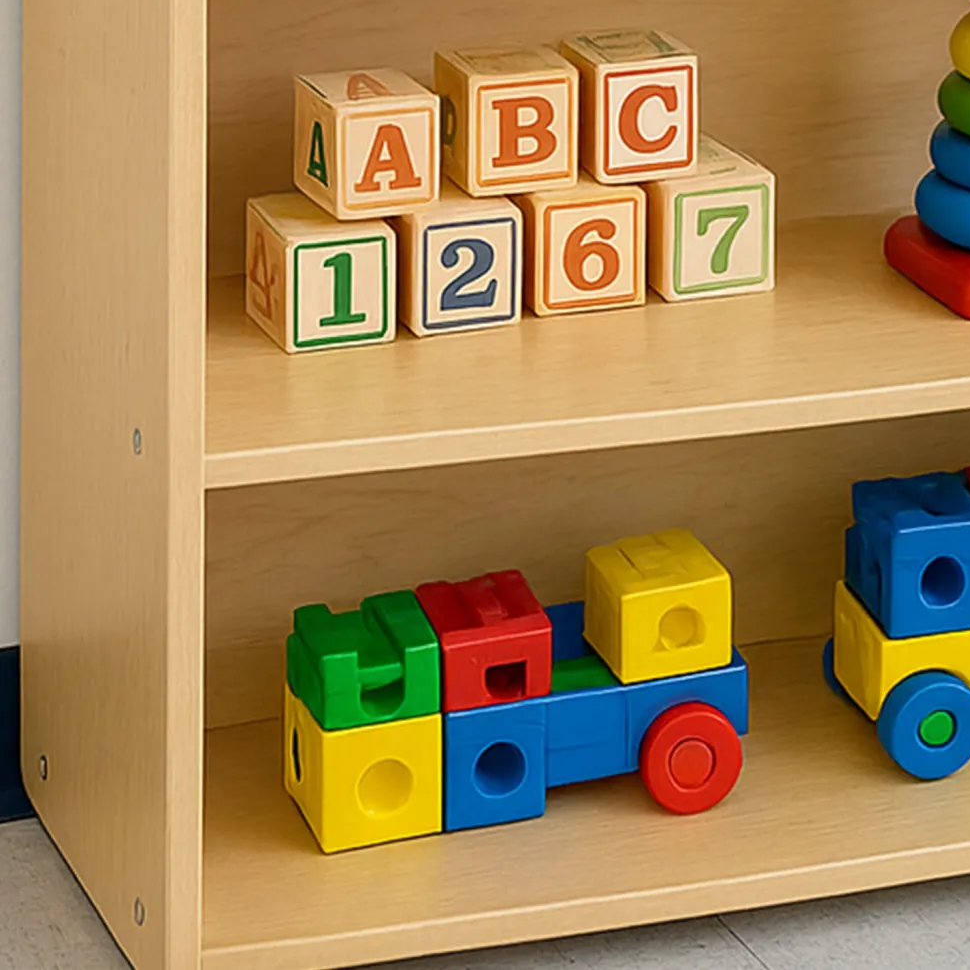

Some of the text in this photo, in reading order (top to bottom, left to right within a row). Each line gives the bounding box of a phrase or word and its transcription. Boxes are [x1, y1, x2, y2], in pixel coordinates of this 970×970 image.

[491, 96, 557, 168] B
[618, 84, 678, 153] C
[307, 121, 328, 188] A
[354, 124, 422, 193] A
[562, 218, 621, 291] 6
[697, 205, 750, 274] 7
[319, 252, 367, 327] 1
[440, 238, 498, 312] 2
